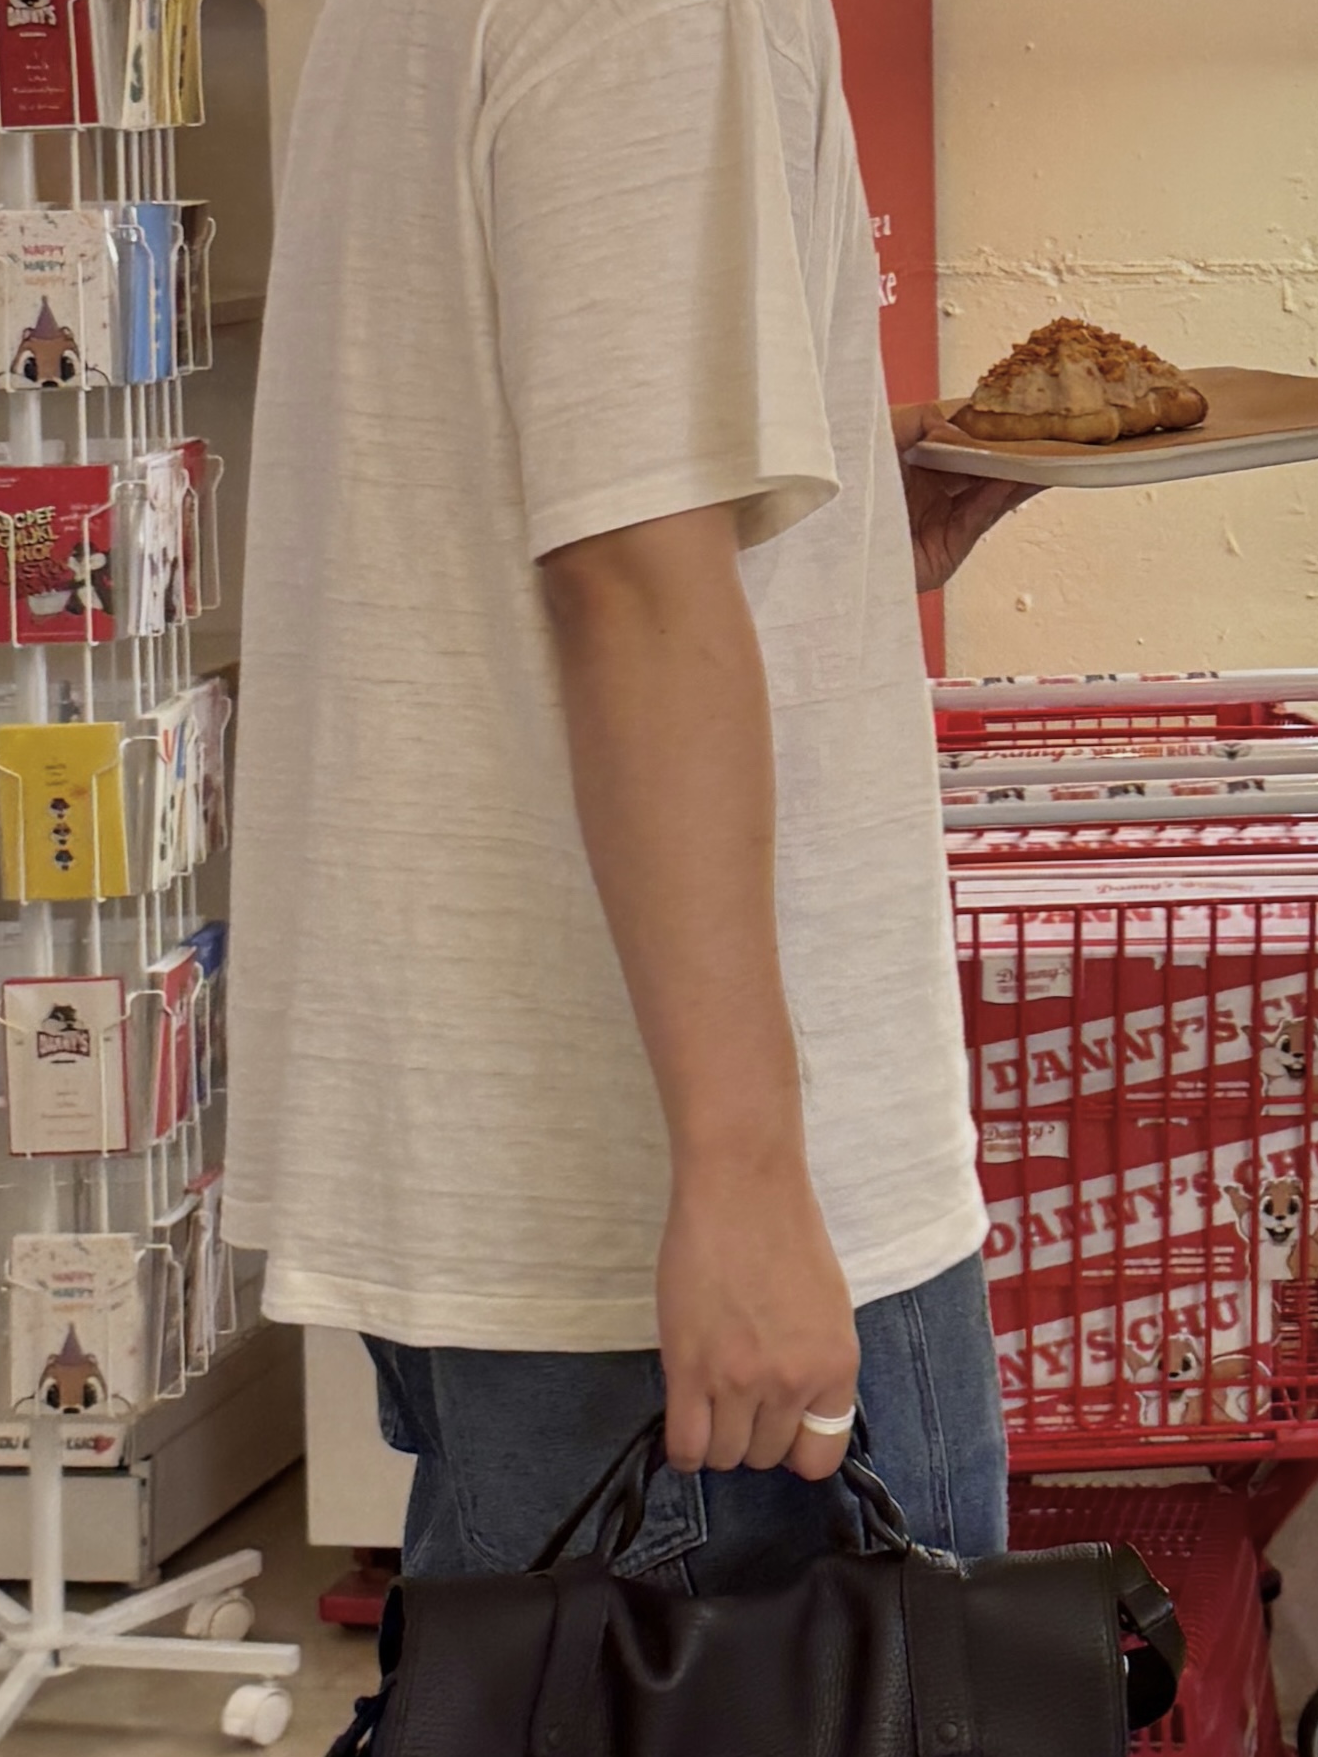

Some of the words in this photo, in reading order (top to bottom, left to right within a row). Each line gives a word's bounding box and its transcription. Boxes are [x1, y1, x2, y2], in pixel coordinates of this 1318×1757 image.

[22, 243, 66, 257] HAPPY
[22, 260, 66, 272] HAPPY
[986, 1007, 1241, 1095] DANNY'S
[983, 1171, 1221, 1260] DANNY'S
[1126, 1293, 1242, 1355] CHU
